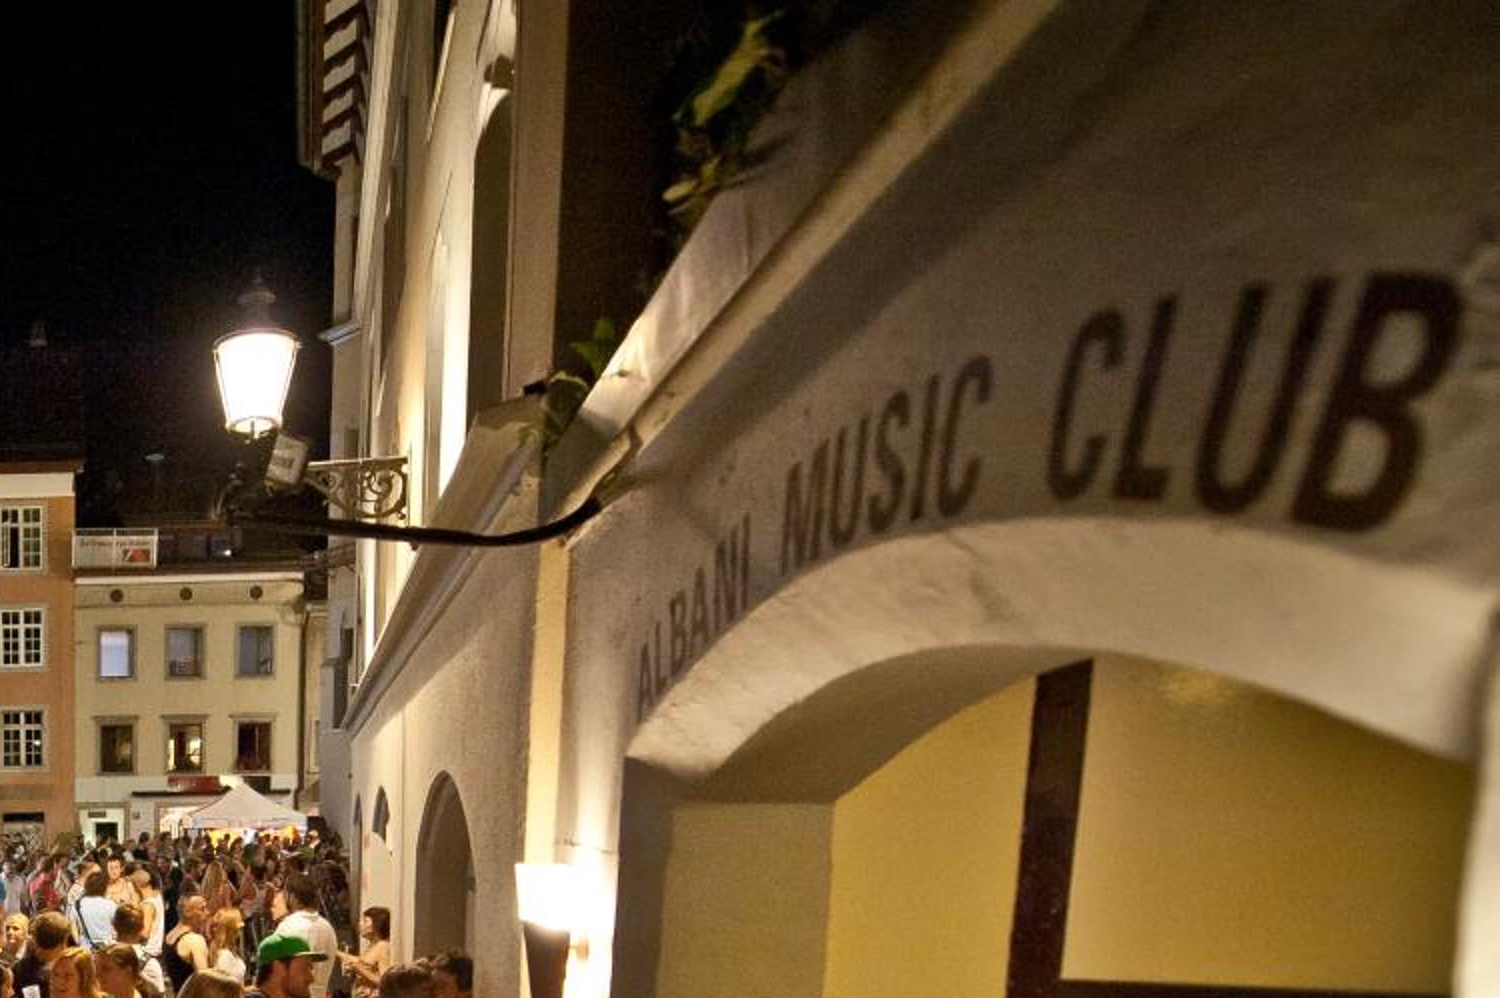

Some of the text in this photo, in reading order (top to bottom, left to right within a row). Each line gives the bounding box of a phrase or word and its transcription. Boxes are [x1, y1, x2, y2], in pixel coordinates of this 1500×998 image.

[636, 269, 1464, 725] ALBANI MUSIC CLUB
